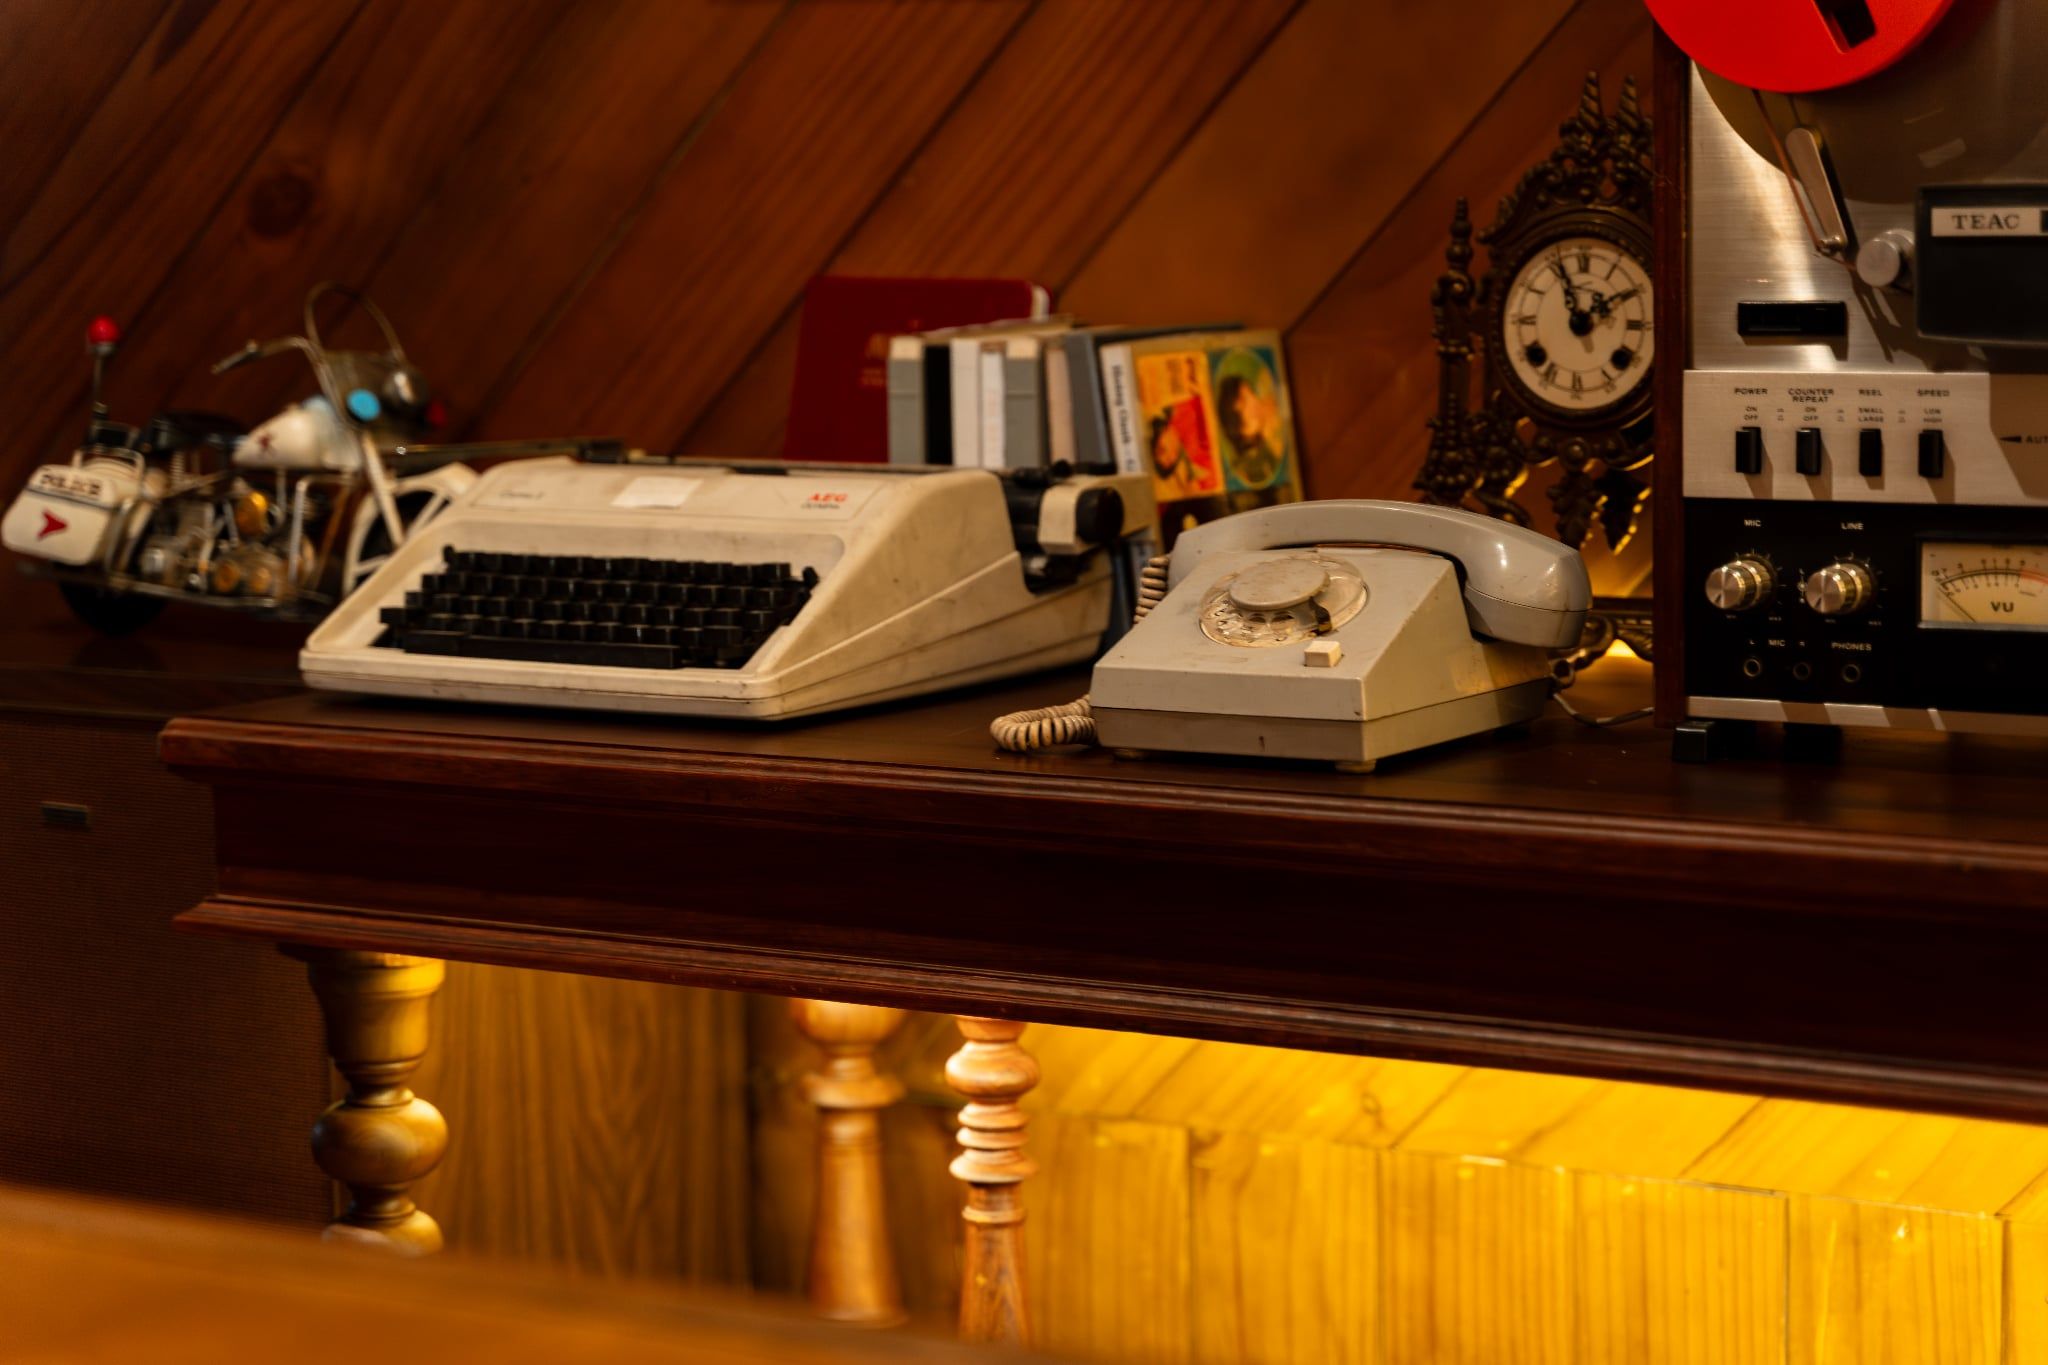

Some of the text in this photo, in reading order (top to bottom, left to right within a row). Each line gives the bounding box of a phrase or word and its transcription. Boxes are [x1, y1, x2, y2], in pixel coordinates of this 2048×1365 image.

[1951, 213, 2020, 230] TEAC
[1734, 387, 1768, 396] POWER
[1787, 387, 1835, 396] COUNTER
[1858, 388, 1883, 397] REEL
[1917, 389, 1950, 398] SPEED
[809, 491, 849, 504] AEG
[1744, 519, 1761, 527] MIC
[1841, 522, 1864, 530] LINE
[1990, 601, 2015, 613] VU
[1768, 639, 1786, 647] MIC
[1831, 642, 1873, 651] PHONES
